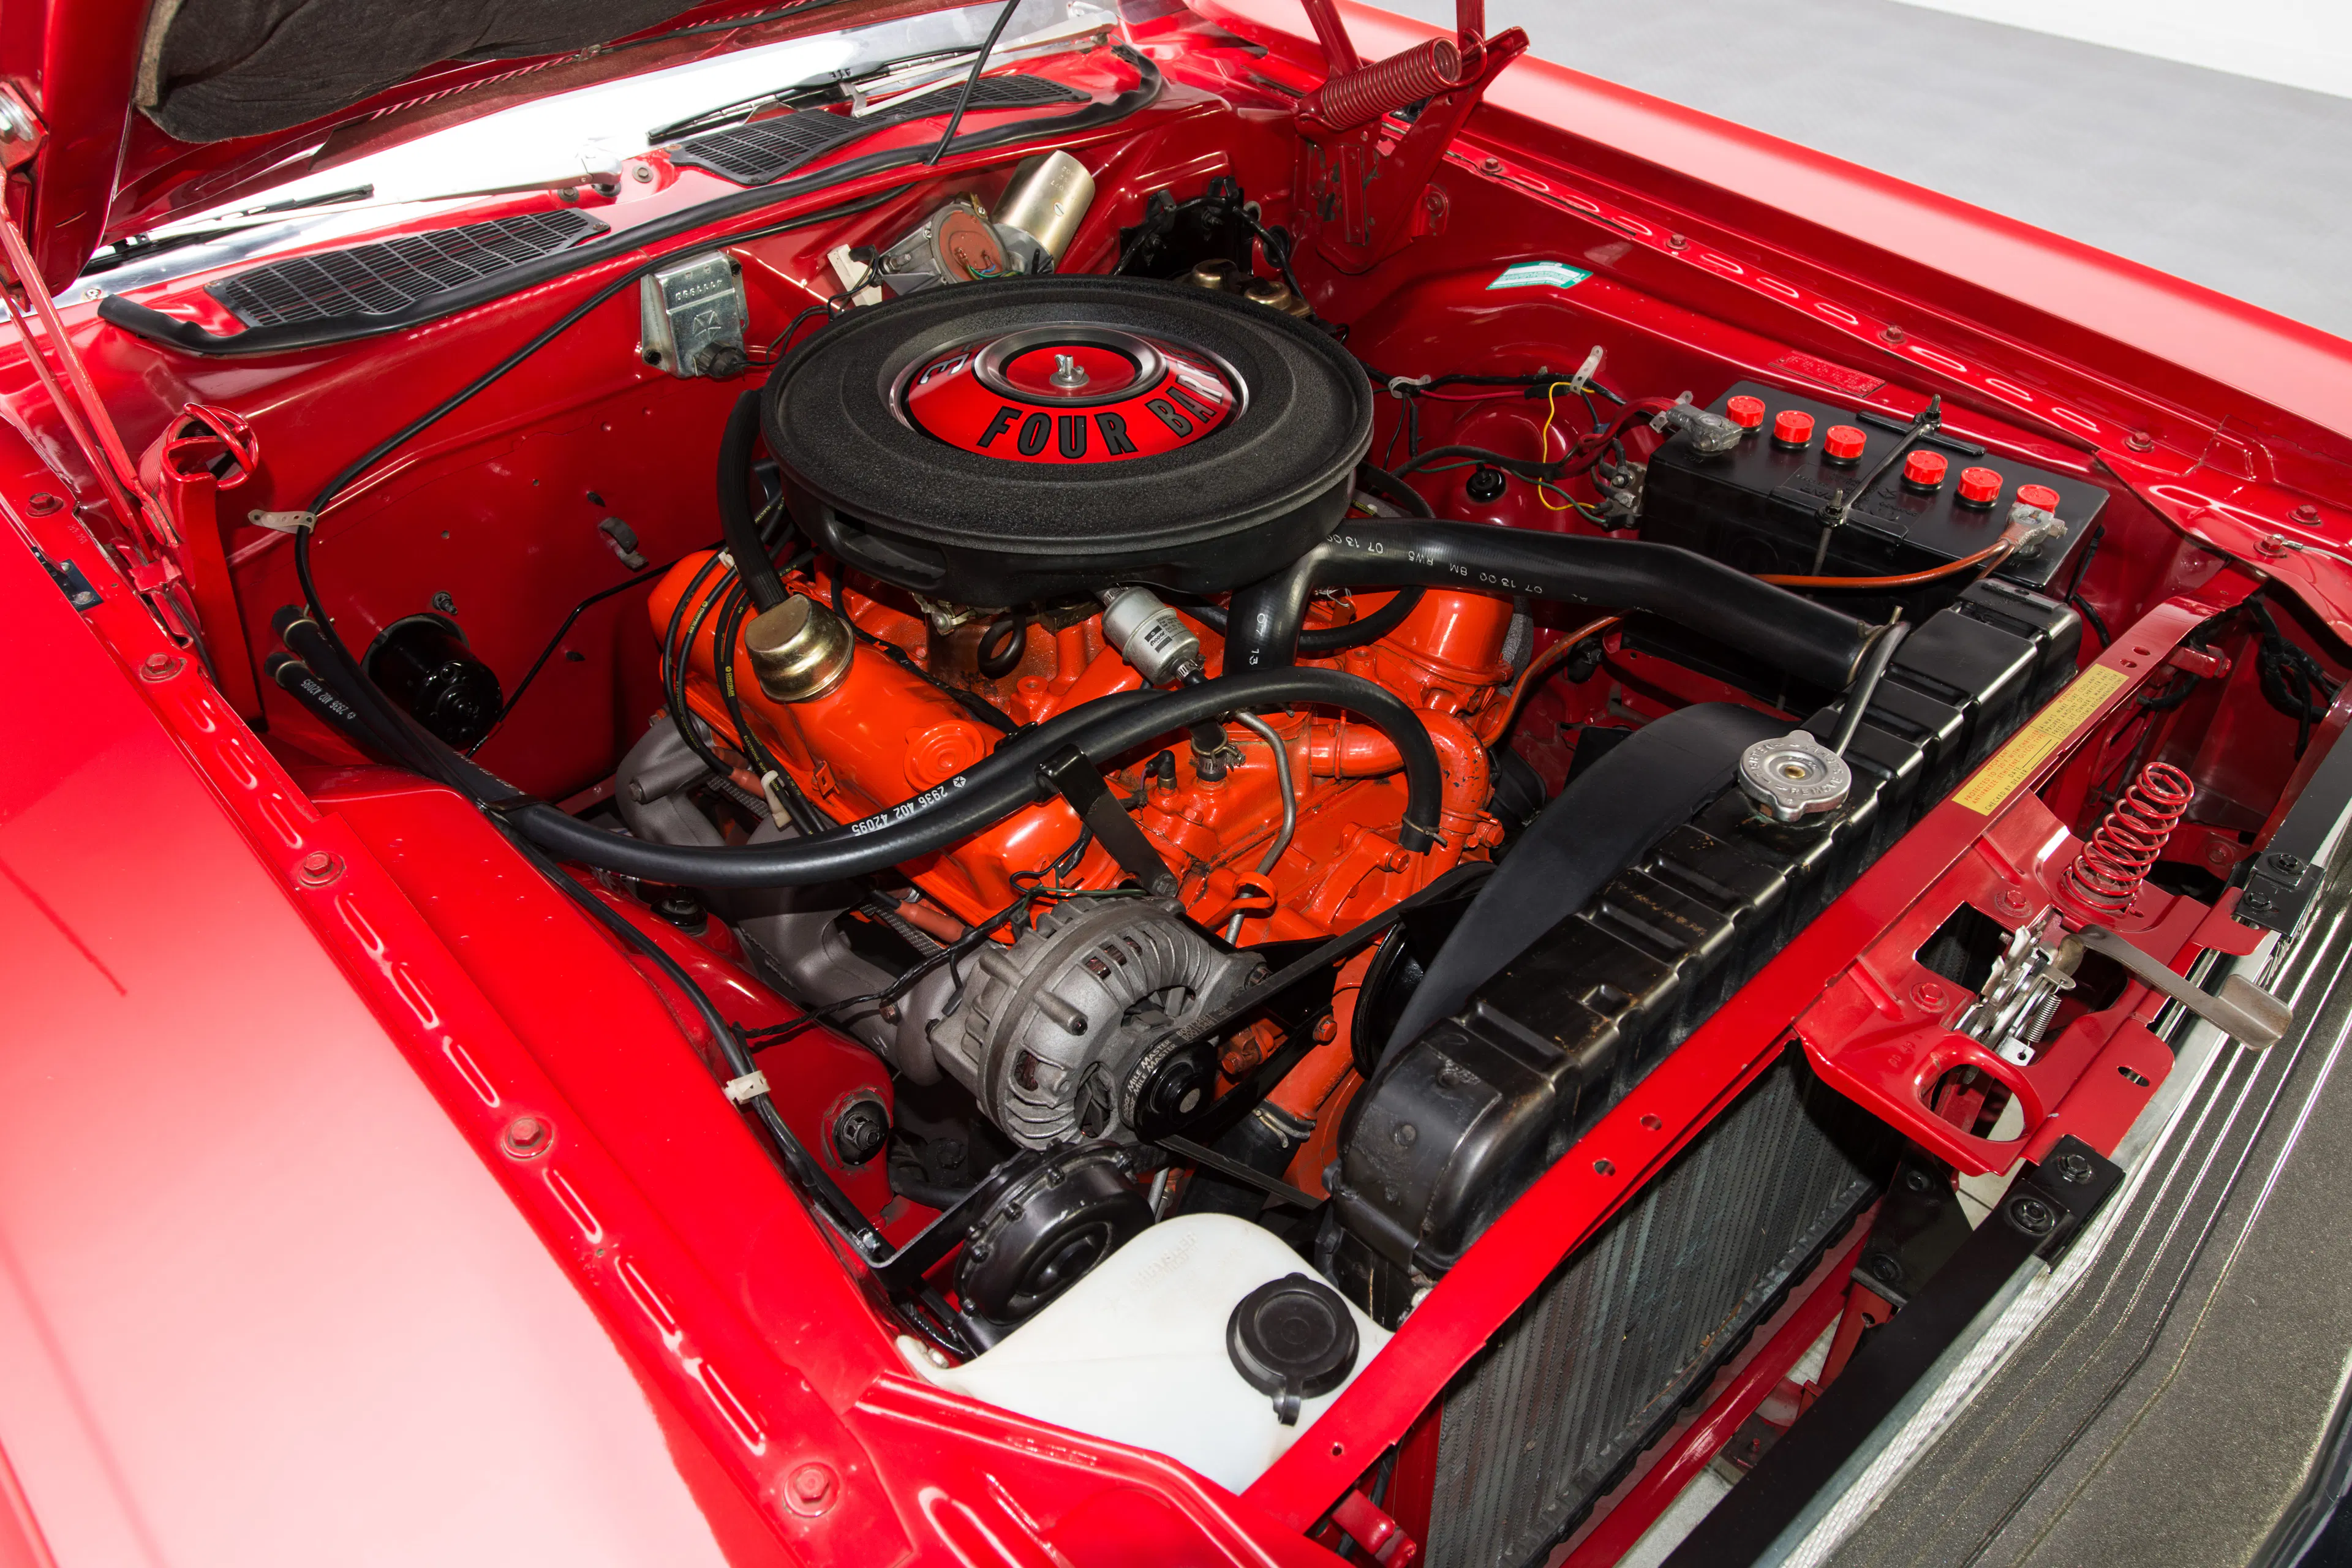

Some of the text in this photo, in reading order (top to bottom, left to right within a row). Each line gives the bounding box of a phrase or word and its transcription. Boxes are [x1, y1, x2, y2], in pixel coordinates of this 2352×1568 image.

[976, 405, 1139, 459] FOUR
[1346, 536, 1360, 548] 13
[1368, 543, 1383, 554] 07
[1501, 578, 1516, 588] 13
[301, 679, 323, 696] 42095
[318, 692, 334, 704] 402
[2057, 686, 2077, 703] WARNING
[2039, 714, 2057, 729] ALWAYS
[2056, 703, 2068, 714] MAKE
[2067, 693, 2079, 703] SURE
[2078, 676, 2097, 693] COOLANT
[2045, 718, 2061, 732] PROPER
[2060, 702, 2078, 718] AMOUNT
[2082, 680, 2101, 697] CHRYSLER
[2059, 722, 2078, 737] COOLING
[2076, 707, 2092, 722] SYSTEMS
[744, 735, 760, 762] ELECTRONIC
[1749, 743, 1775, 777] TIGHTEN
[1985, 749, 2010, 772] IMPORTANT
[1964, 778, 1990, 801] PROTECTED
[2008, 747, 2020, 759] WITH
[2019, 729, 2040, 748] CHRYSLER
[2008, 766, 2021, 778] DATE
[1790, 776, 1843, 796] REMOVE
[1972, 780, 1999, 804] ANTIFREEZE
[1985, 791, 2007, 810] CHECKED
[2011, 769, 2027, 785] DEALER
[851, 786, 948, 836] 2936 402 42095
